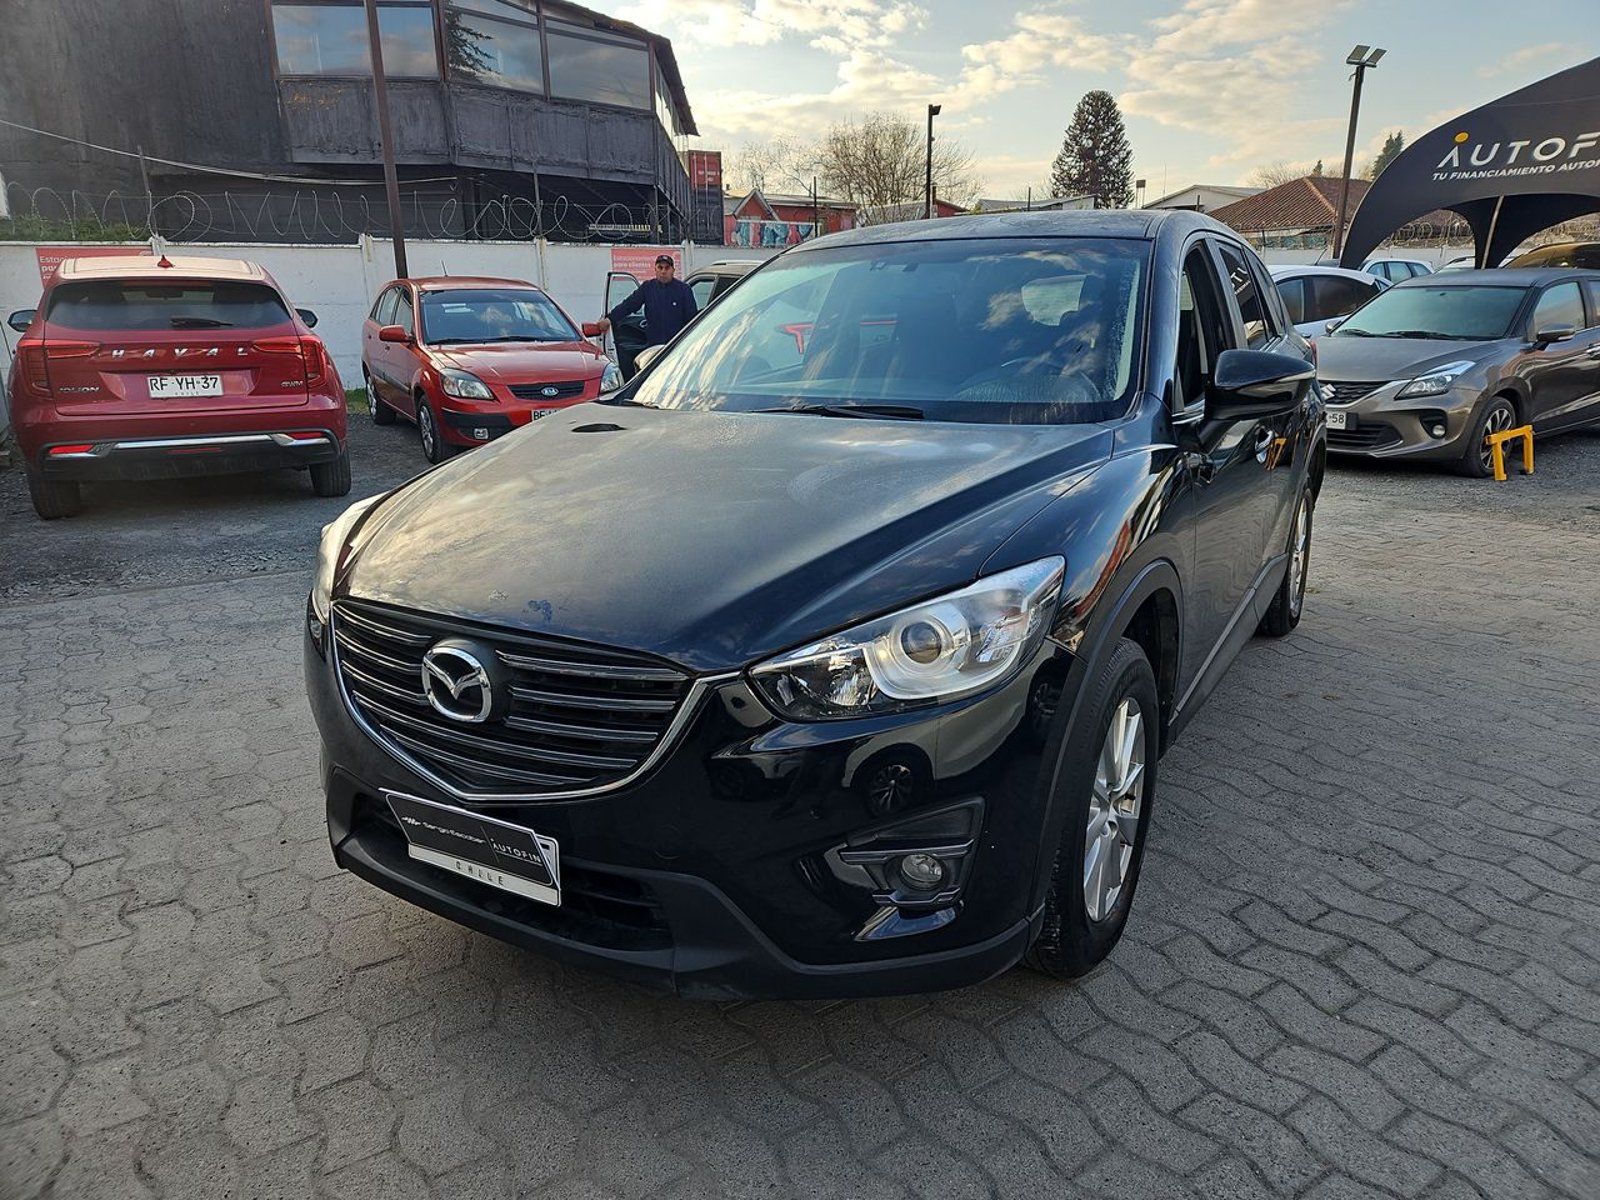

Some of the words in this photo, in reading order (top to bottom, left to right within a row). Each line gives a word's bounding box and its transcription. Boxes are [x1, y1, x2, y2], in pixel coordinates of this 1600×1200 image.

[1433, 172, 1446, 180] TU
[1450, 165, 1555, 180] FINANCIAMIENTO
[111, 347, 249, 357] HAVAL
